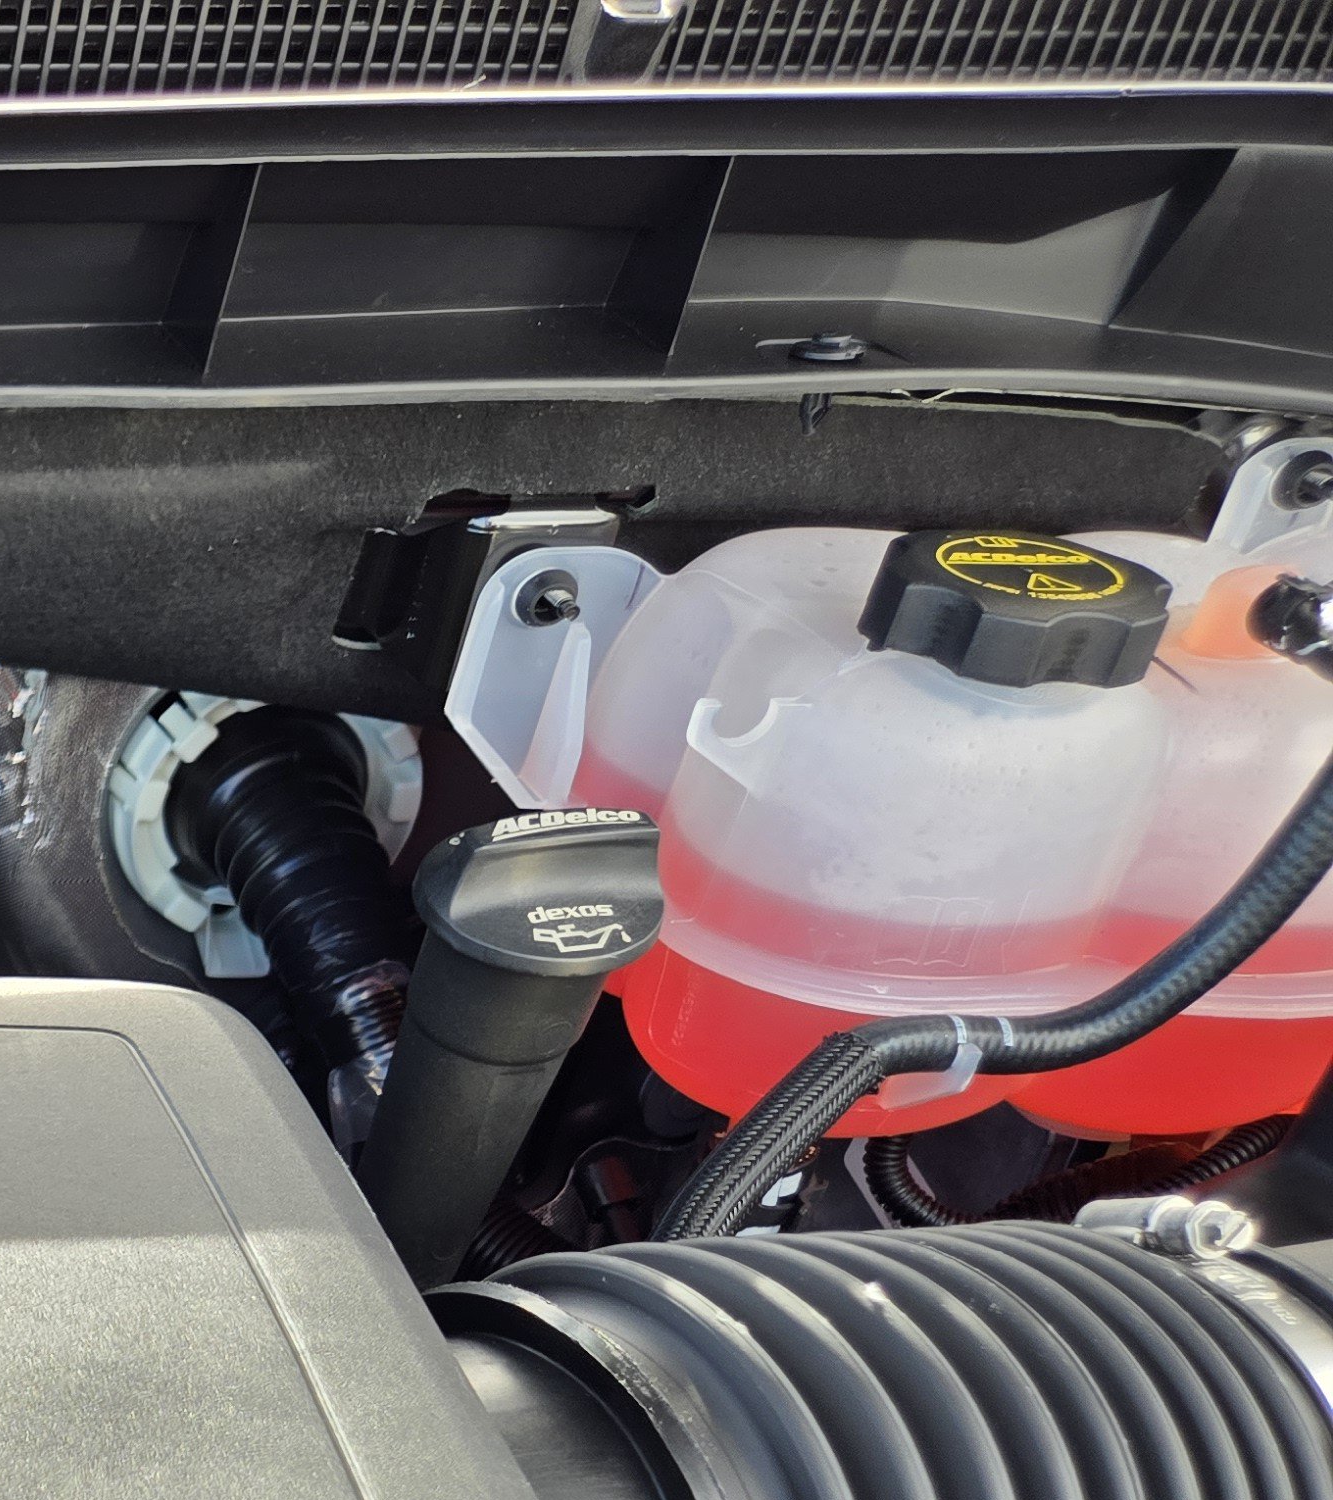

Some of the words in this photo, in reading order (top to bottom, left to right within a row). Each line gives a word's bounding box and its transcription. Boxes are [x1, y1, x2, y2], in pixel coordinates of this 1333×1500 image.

[948, 552, 1090, 564] ACDelco
[491, 808, 641, 838] ACDelco
[527, 904, 614, 924] dexos
